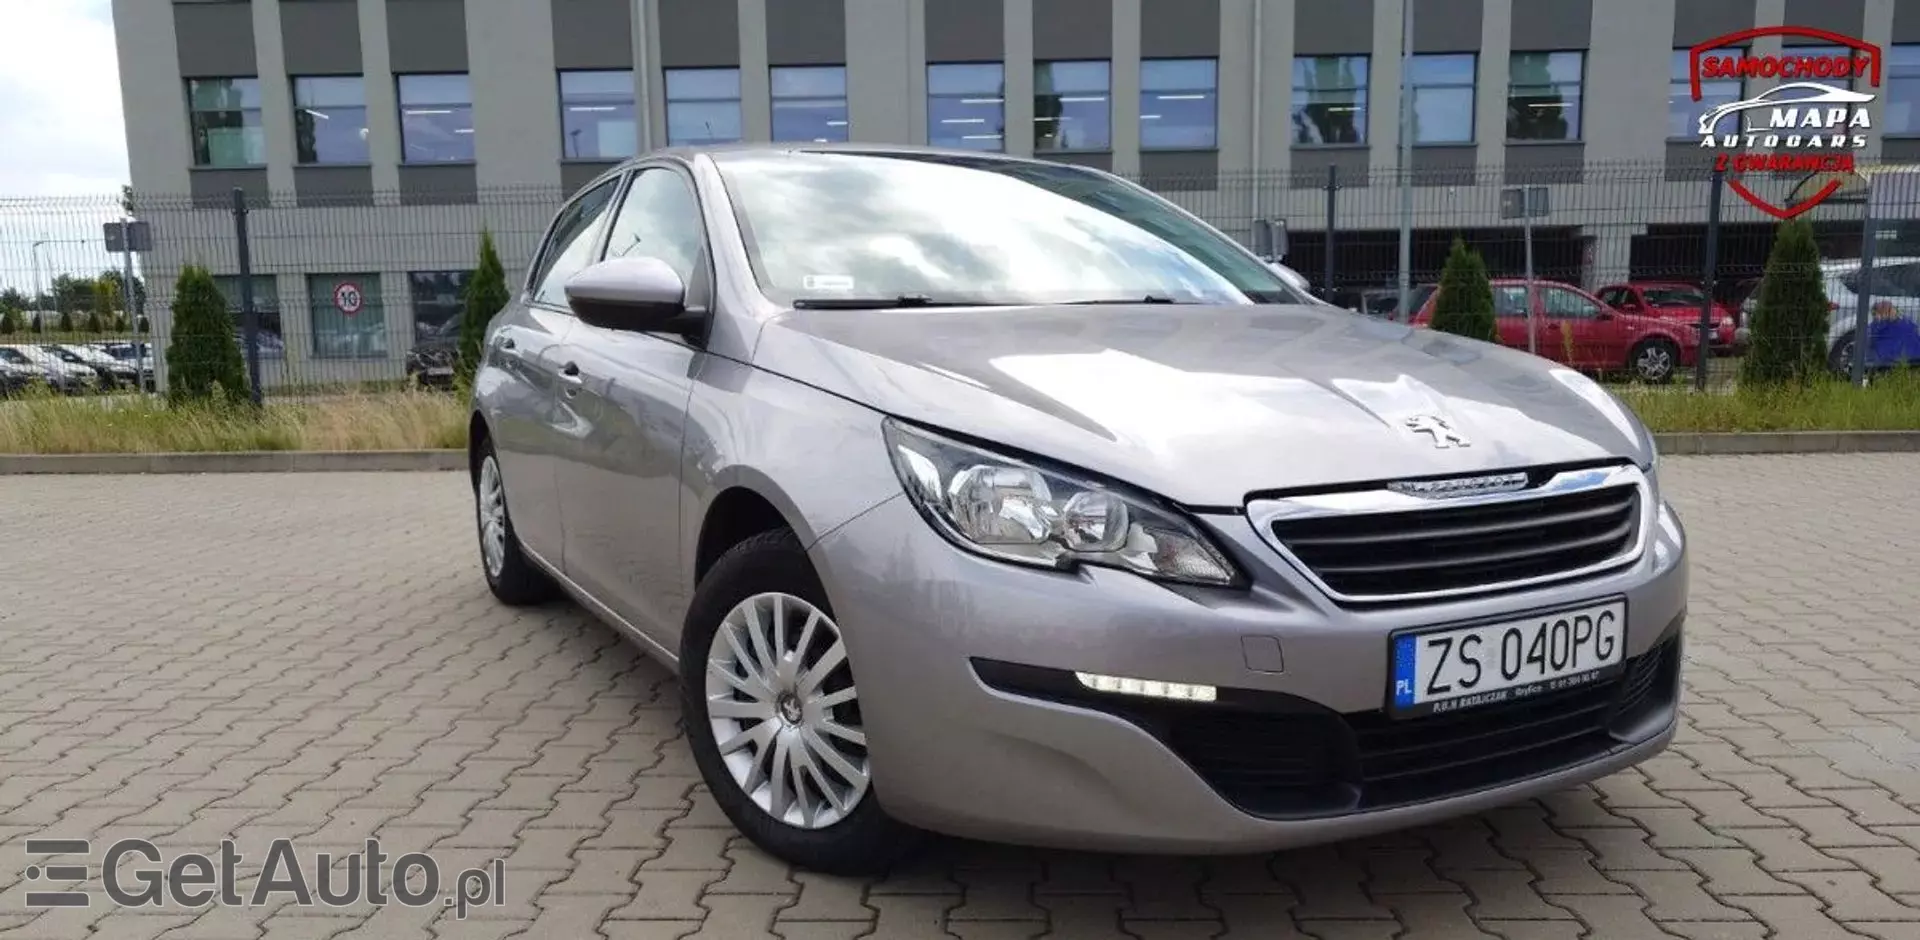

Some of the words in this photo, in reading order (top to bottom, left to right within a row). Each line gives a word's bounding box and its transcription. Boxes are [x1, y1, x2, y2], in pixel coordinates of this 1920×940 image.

[341, 291, 358, 307] 10
[1427, 633, 1483, 696] ZS
[1501, 609, 1615, 681] 040PG
[1396, 679, 1413, 696] PL
